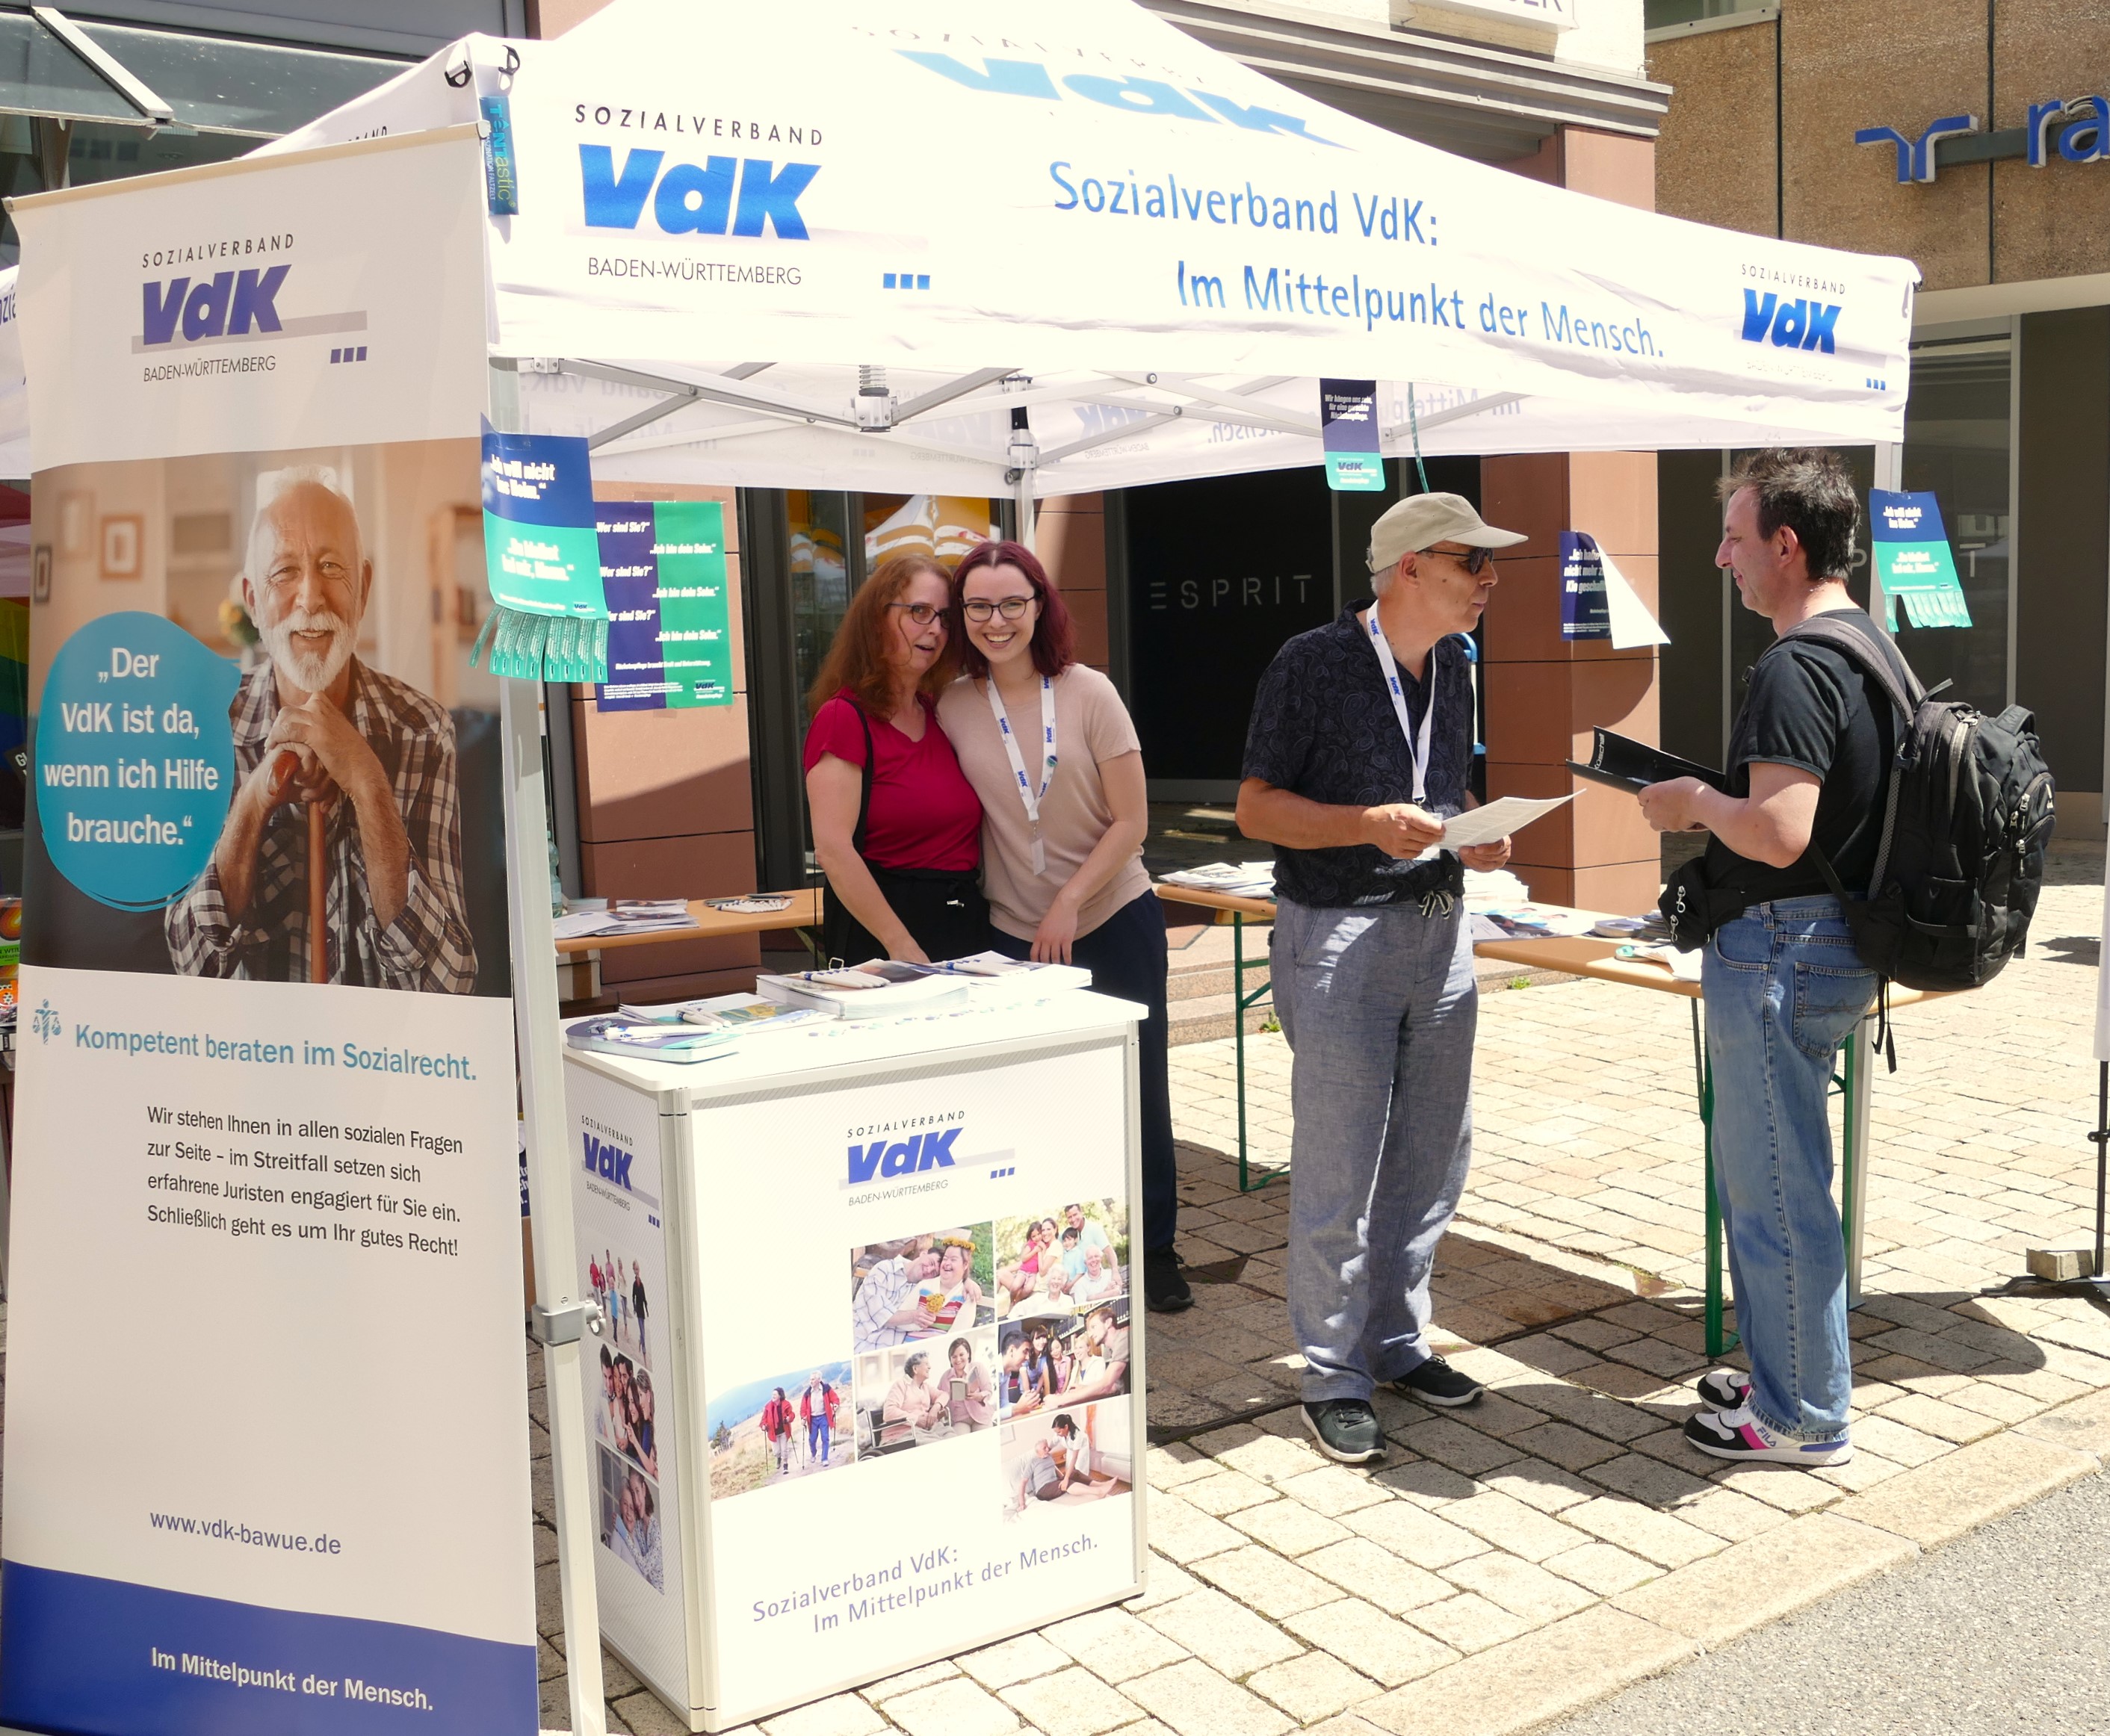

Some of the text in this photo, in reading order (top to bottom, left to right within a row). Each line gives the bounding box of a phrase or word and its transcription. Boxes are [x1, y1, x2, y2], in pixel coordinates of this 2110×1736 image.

[575, 103, 823, 146] SOZIALVERBAND
[578, 143, 822, 241] VdK
[1049, 161, 1437, 246] Sozialverband VdK:
[142, 232, 295, 269] SOZIALVERBAND
[588, 256, 802, 285] BADEN-WÜRTTEMBERG
[1742, 264, 1846, 295] SOZIALVERBAND
[143, 263, 292, 346] VdK
[1178, 261, 1663, 357] Im Mittelpunkt der Mensch.
[1742, 288, 1843, 355] VdK
[143, 354, 276, 382] BADEN-WÜRTTEMBERG
[524, 462, 555, 480] nicht
[1337, 462, 1363, 471] VdK
[596, 521, 612, 533] Wer
[612, 521, 628, 533] sind
[665, 544, 678, 554] bin
[677, 544, 693, 554] dein
[599, 566, 615, 577] Wer
[615, 565, 631, 577] sind
[1564, 565, 1582, 577] nicht
[1582, 565, 1598, 577] mehr
[1565, 580, 1579, 592] Klo
[668, 587, 681, 598] bin
[681, 586, 697, 598] dein
[1150, 574, 1312, 610] ESPRIT
[619, 610, 635, 621] sind
[1370, 619, 1380, 636] VdK
[671, 630, 683, 642] bin
[683, 630, 699, 642] dein
[97, 648, 159, 683] „Der
[1390, 677, 1401, 695] VdK
[61, 703, 199, 740] VdK ist da,
[1000, 718, 1009, 734] VdK
[44, 759, 219, 790] wenn ich Hilfe
[1018, 770, 1028, 787] VdK
[67, 814, 192, 845] brauche.“
[75, 1023, 477, 1081] Kompetent beraten im Sozialrecht.
[147, 1106, 463, 1155] Wir stehen Ihnen in allen sozialen Fragen
[581, 1115, 634, 1147] SOZIALVERBAND
[847, 1110, 965, 1138] SOZIALVERBAND
[147, 1142, 170, 1156] zur
[175, 1141, 211, 1162] Seite
[229, 1149, 248, 1167] im
[254, 1151, 328, 1172] Streitfall
[334, 1158, 386, 1178] setzen
[390, 1163, 421, 1182] sich
[583, 1132, 634, 1191] VdK
[847, 1127, 964, 1184] VdK
[147, 1174, 461, 1223] erfahrene Juristen engagiert für Sie ein.
[848, 1179, 949, 1206] BADEN-WÜRTTEMBERG
[147, 1205, 458, 1256] Schließlich geht es um Ihr gutes Recht!
[1757, 1426, 1777, 1448] FILA
[149, 1512, 341, 1554] www.vdk-bawue.de
[752, 1546, 959, 1622] Sozialverband VdK:
[814, 1533, 1098, 1634] Im Mittelpunkt der Mensch.
[151, 1646, 434, 1711] Im Mittelpunkt der Mensch.
